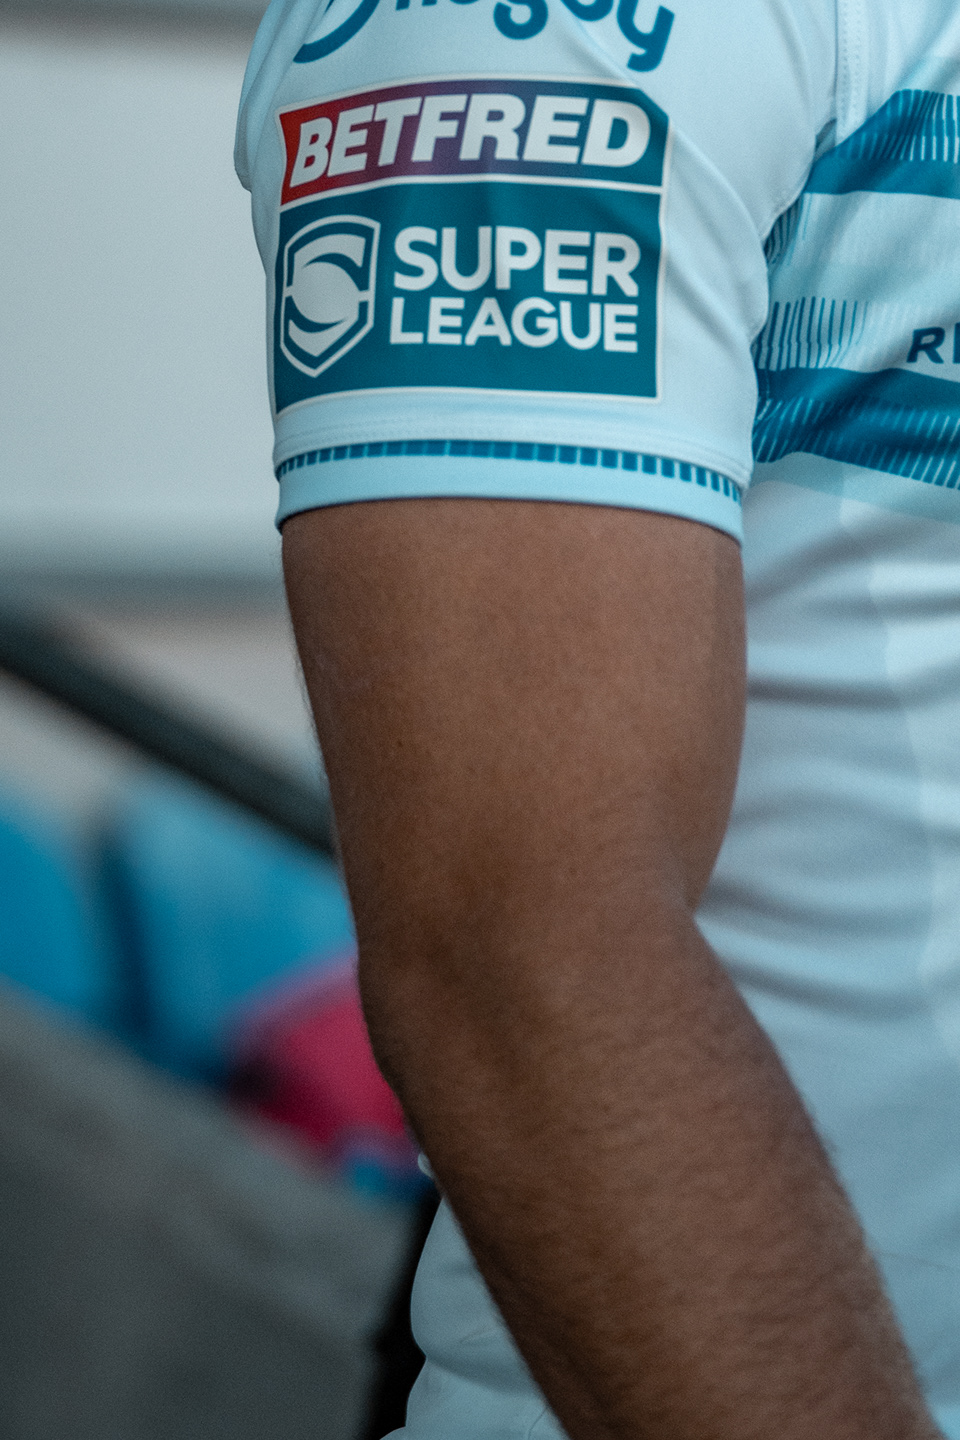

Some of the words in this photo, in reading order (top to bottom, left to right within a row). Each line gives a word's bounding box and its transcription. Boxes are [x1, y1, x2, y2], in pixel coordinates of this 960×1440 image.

[289, 93, 651, 188] BETFRED
[393, 225, 641, 297] SUPER
[389, 296, 639, 353] LEAGUE
